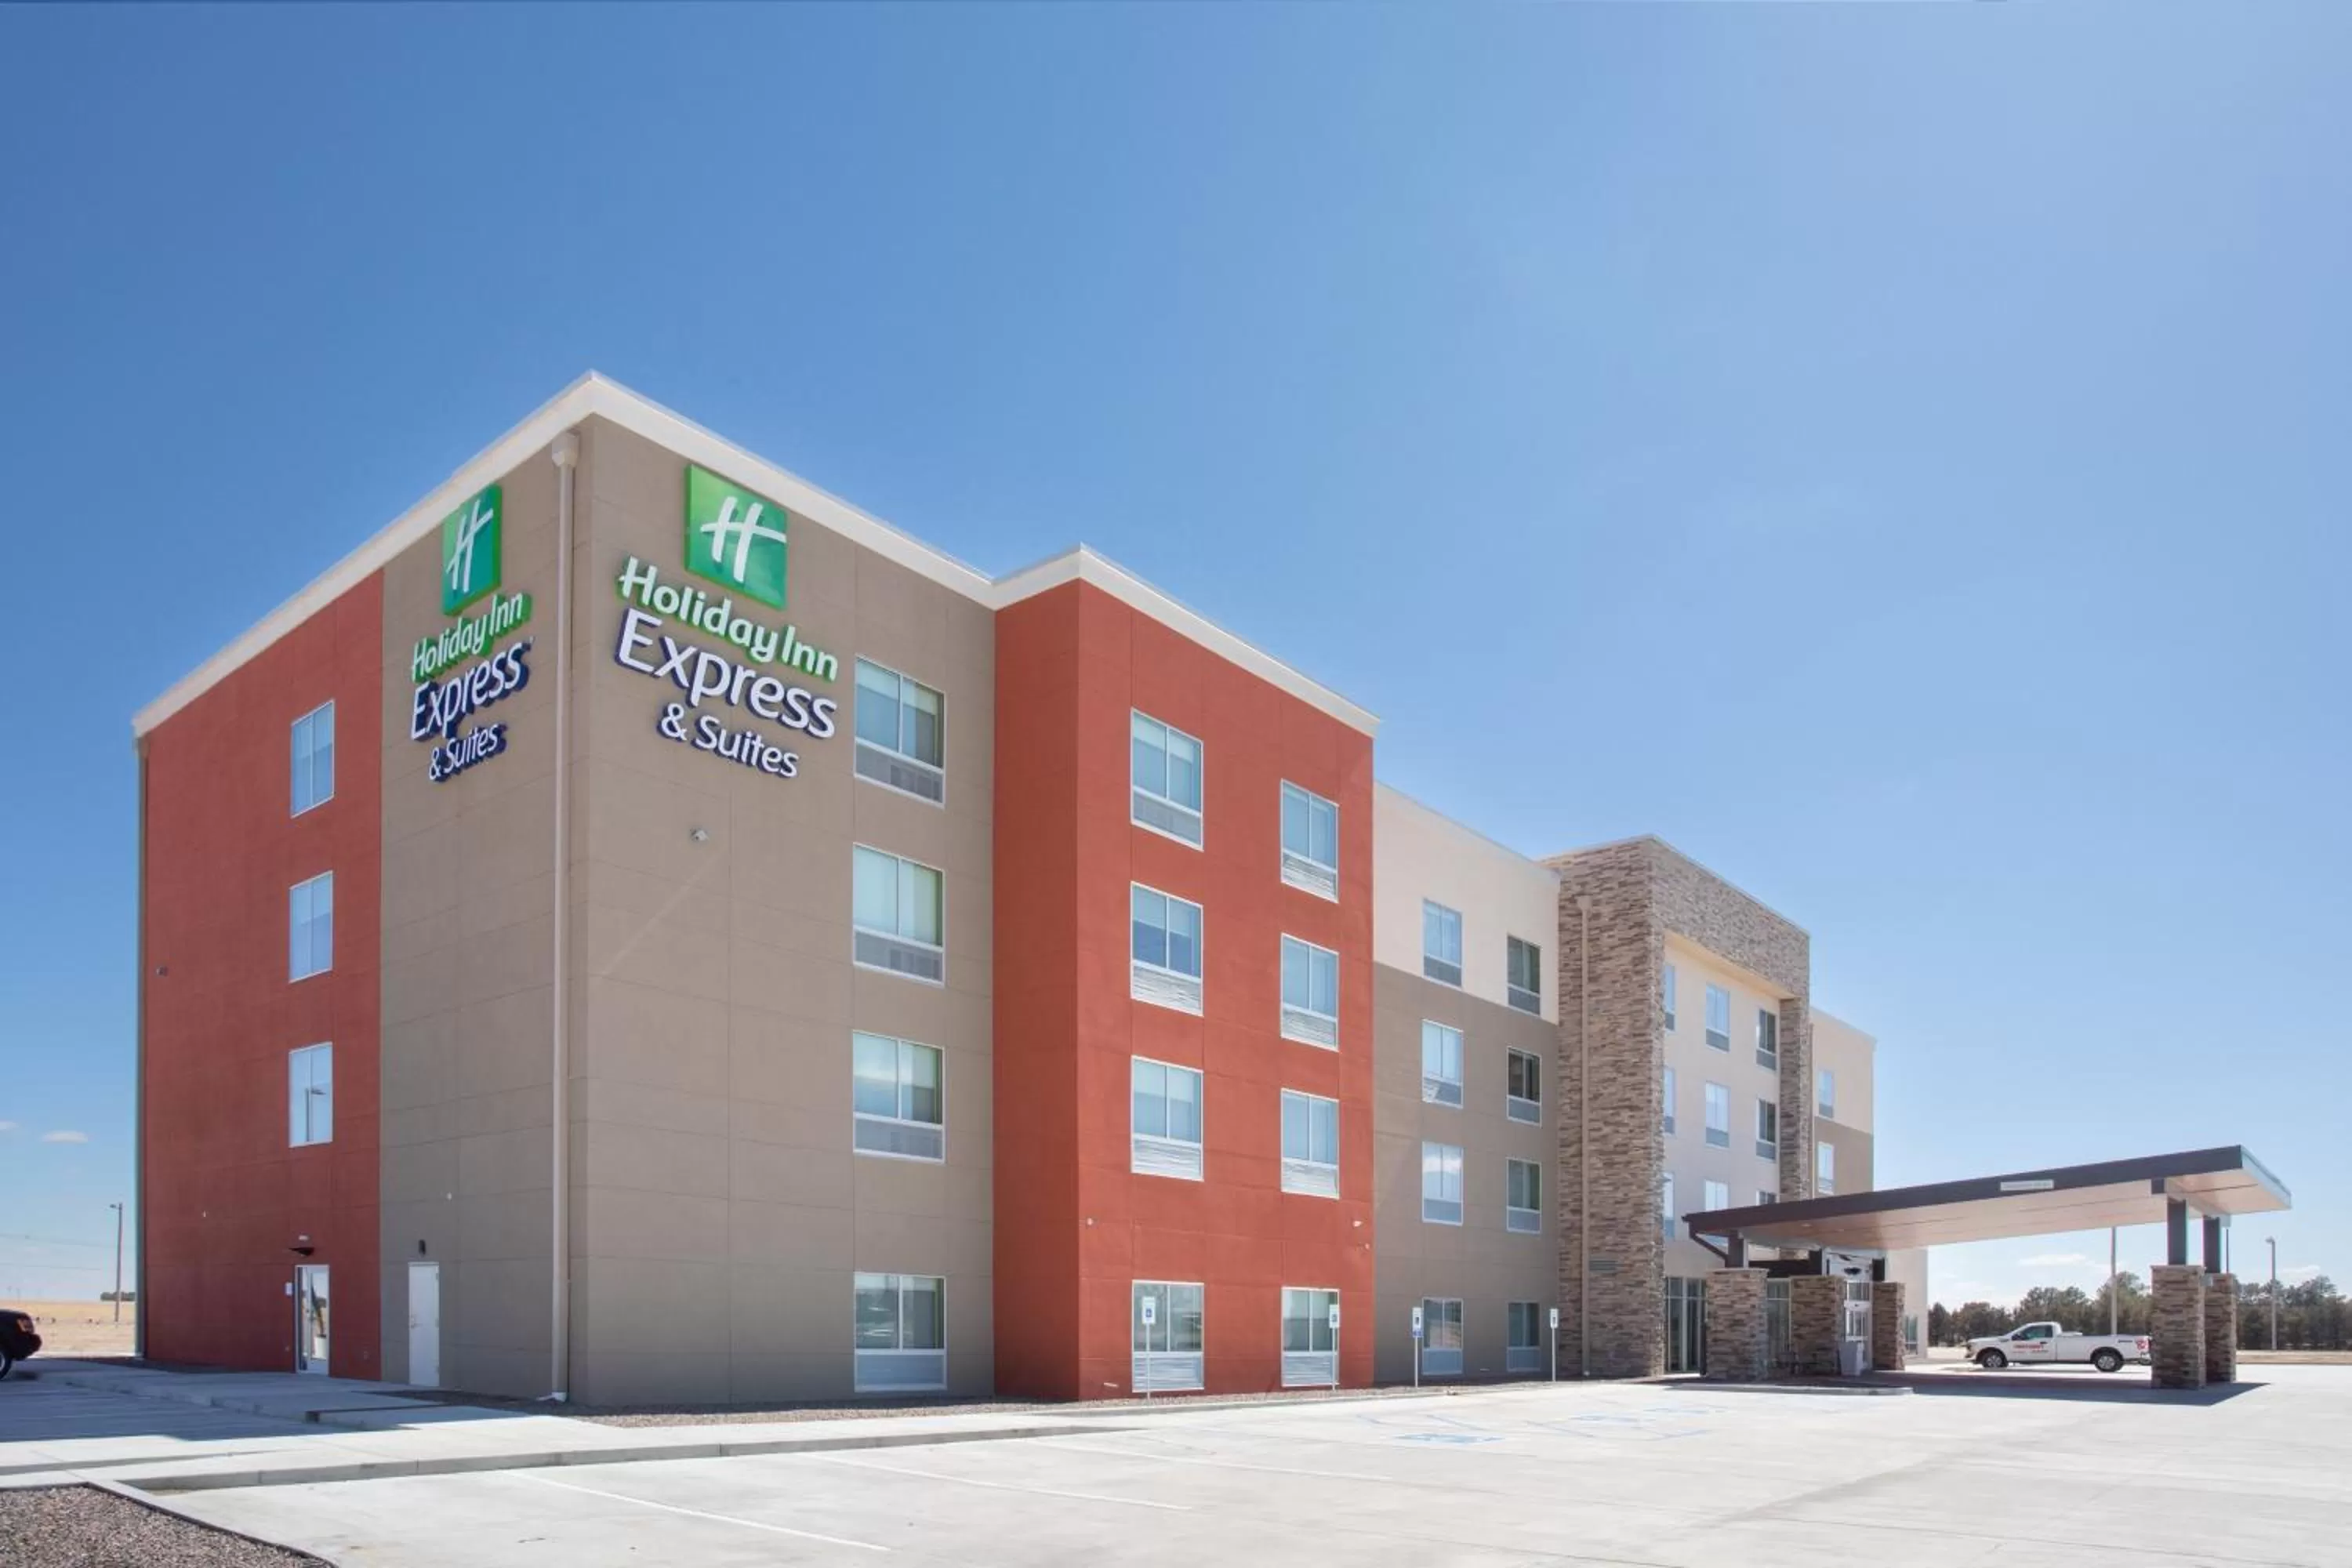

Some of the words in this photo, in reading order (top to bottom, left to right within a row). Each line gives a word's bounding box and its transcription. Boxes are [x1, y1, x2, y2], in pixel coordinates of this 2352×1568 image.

[411, 614, 488, 682] Holiday
[488, 592, 524, 637] Inn
[617, 554, 779, 663] Holiday
[782, 623, 839, 682] Inn
[410, 641, 523, 740] Express
[616, 607, 838, 739] Express
[429, 746, 442, 780] &
[443, 723, 500, 774] Suites
[659, 702, 688, 741] &
[693, 713, 800, 778] Suites
